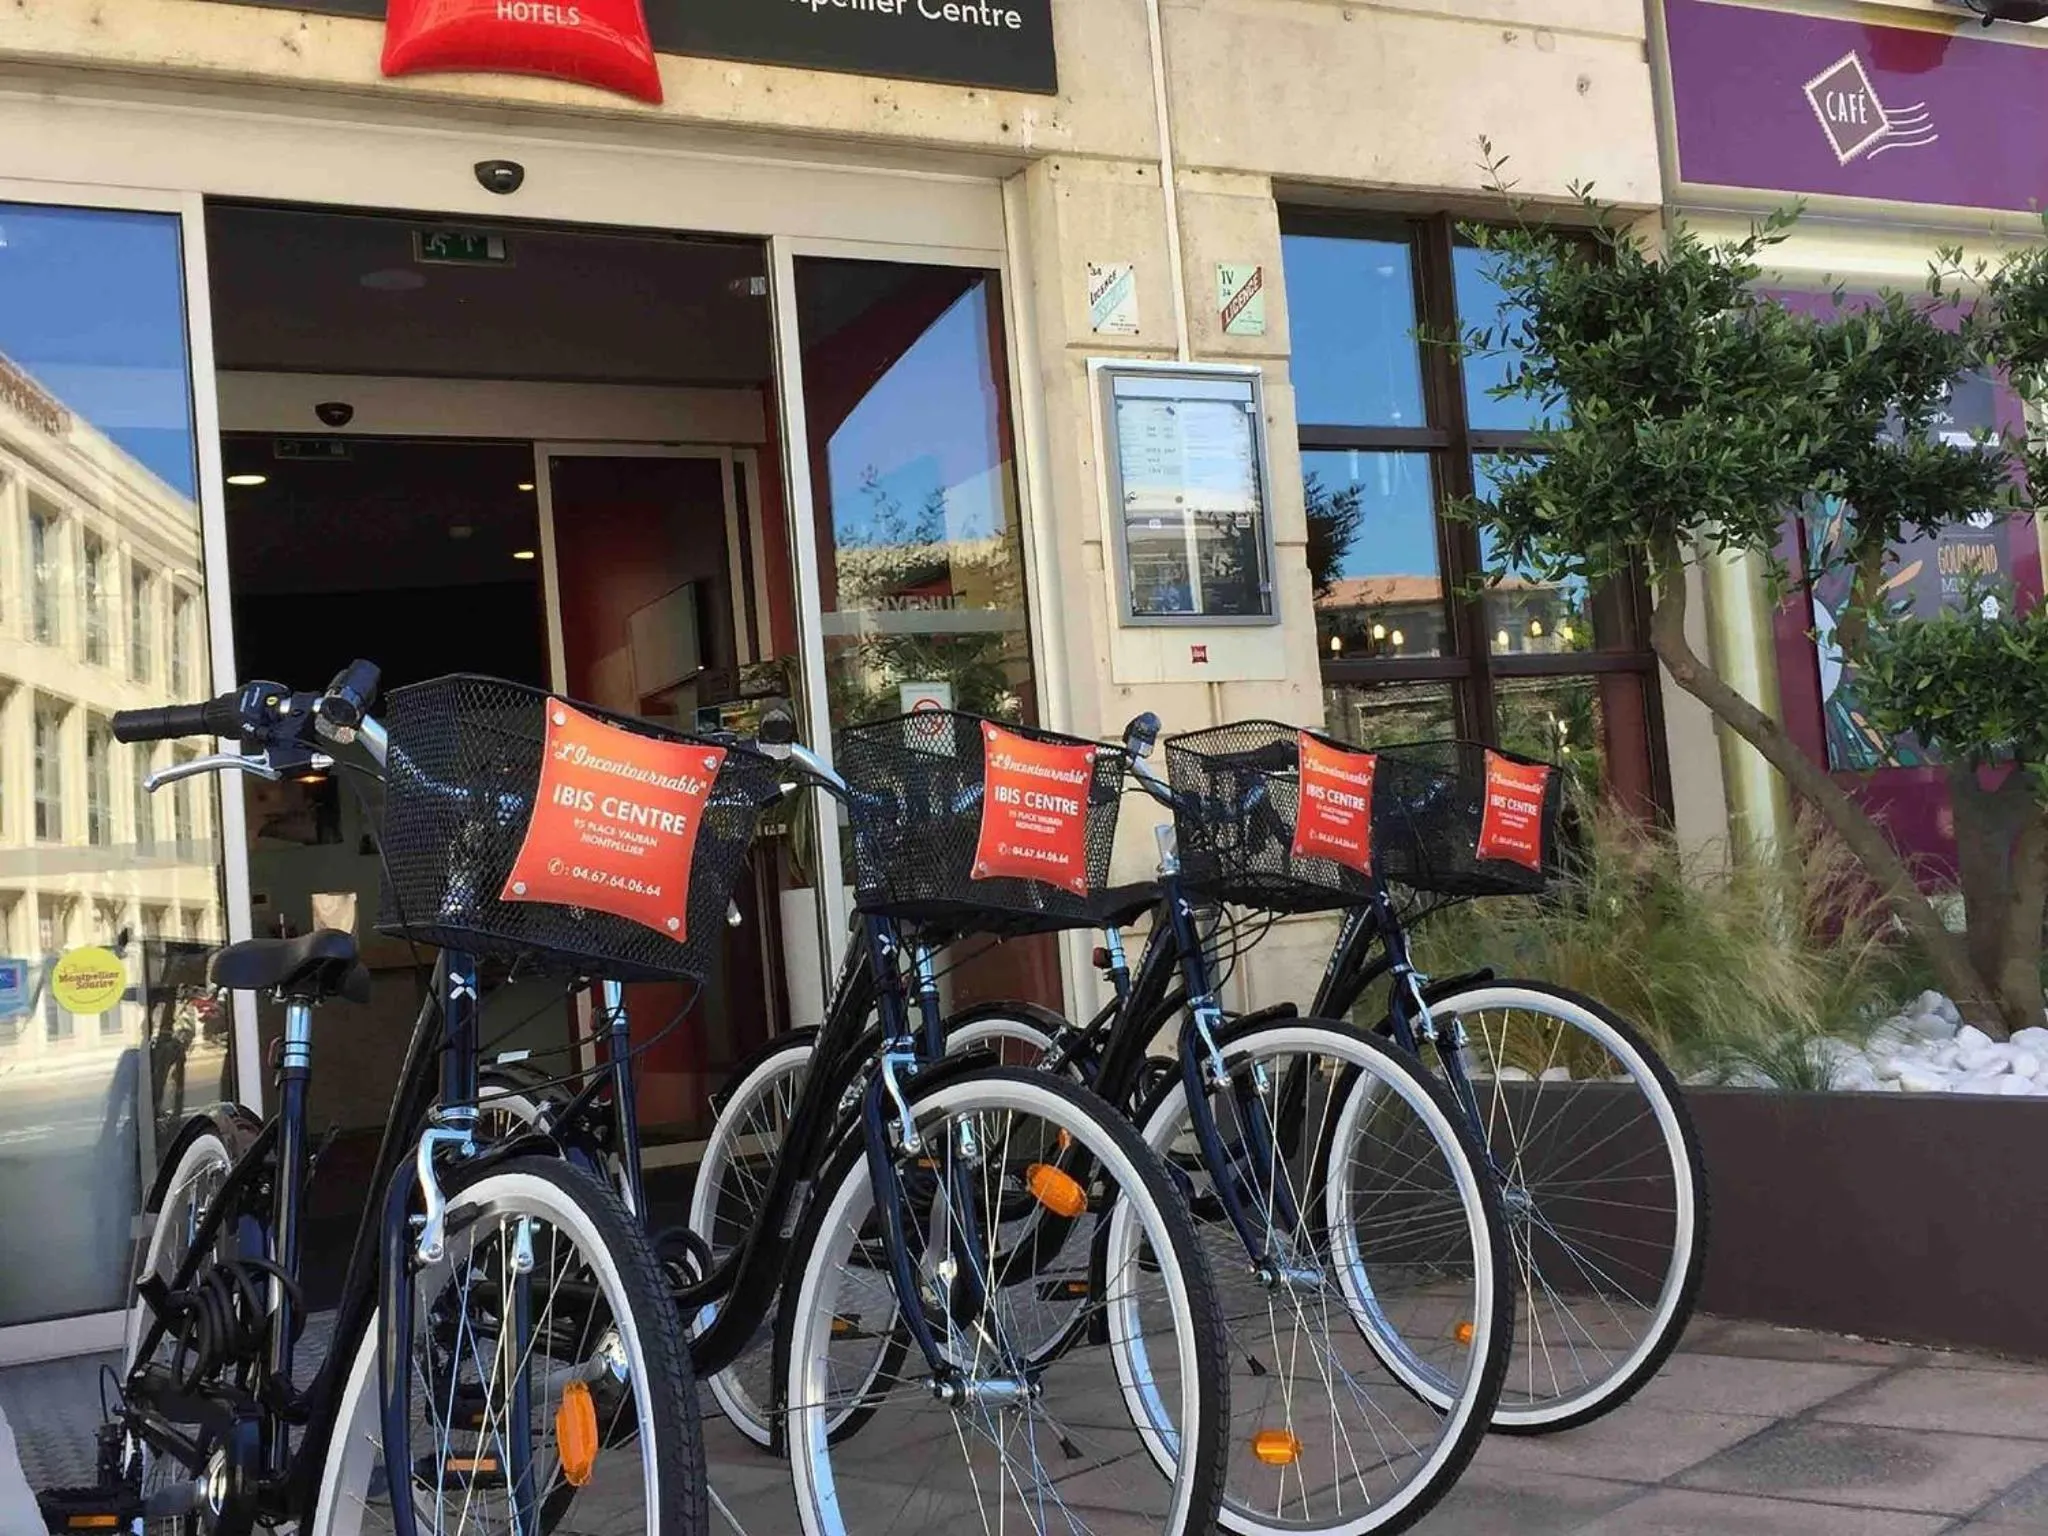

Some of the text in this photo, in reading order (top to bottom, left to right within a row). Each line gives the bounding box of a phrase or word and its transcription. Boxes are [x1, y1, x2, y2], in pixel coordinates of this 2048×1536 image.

[497, 0, 580, 26] HOTELS
[917, 0, 1022, 29] Centre
[1826, 86, 1868, 124] CAFÉ
[1222, 270, 1234, 284] IV
[553, 784, 687, 835] IBIS CENTRE
[994, 785, 1079, 816] IBIS CENTRE
[1306, 783, 1325, 800] IBIS
[1327, 790, 1365, 812] CENTRE
[1507, 798, 1538, 816] CENTRE
[572, 866, 662, 896] 04.67.64.06.64
